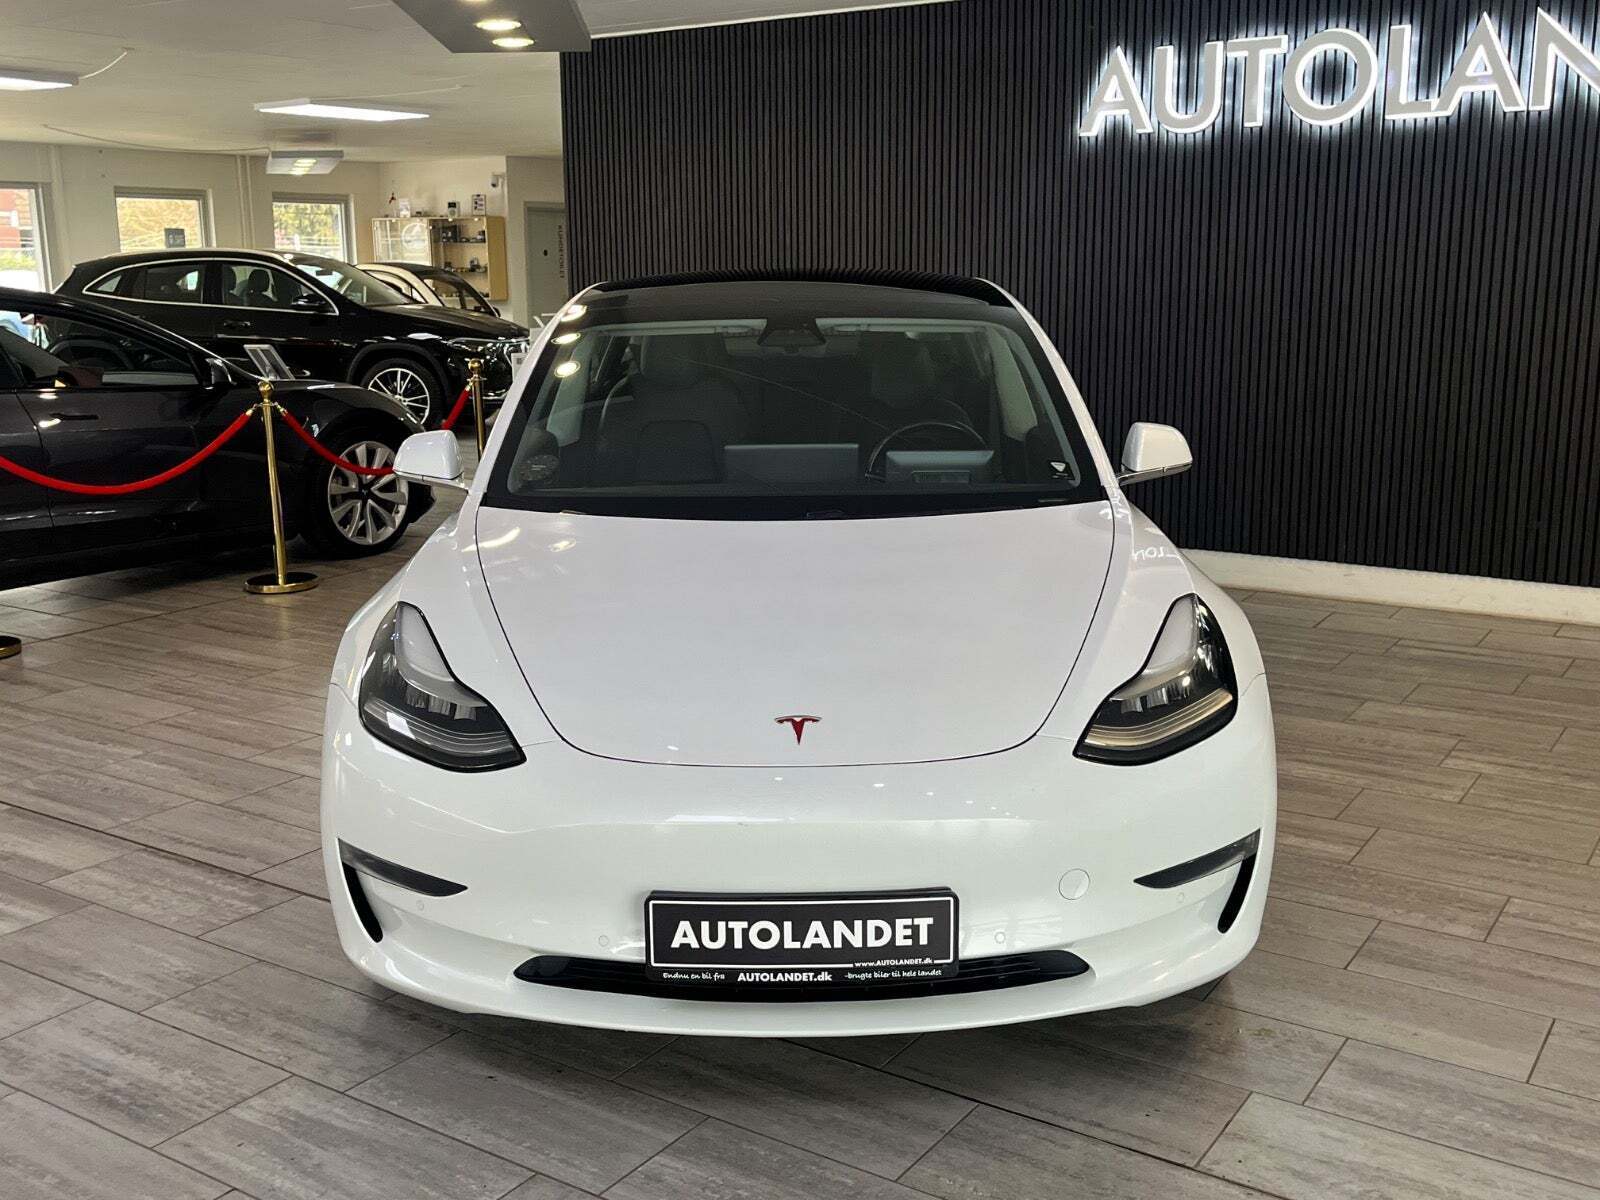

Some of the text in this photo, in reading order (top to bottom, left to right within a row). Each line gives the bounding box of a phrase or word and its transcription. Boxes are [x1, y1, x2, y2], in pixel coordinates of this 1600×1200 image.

[1078, 6, 1600, 137] AUTOLAN
[670, 917, 934, 950] AUTOLANDET
[854, 957, 933, 967] www.AUTOLANDET.dk
[737, 971, 833, 982] AUTOLANDET.dk
